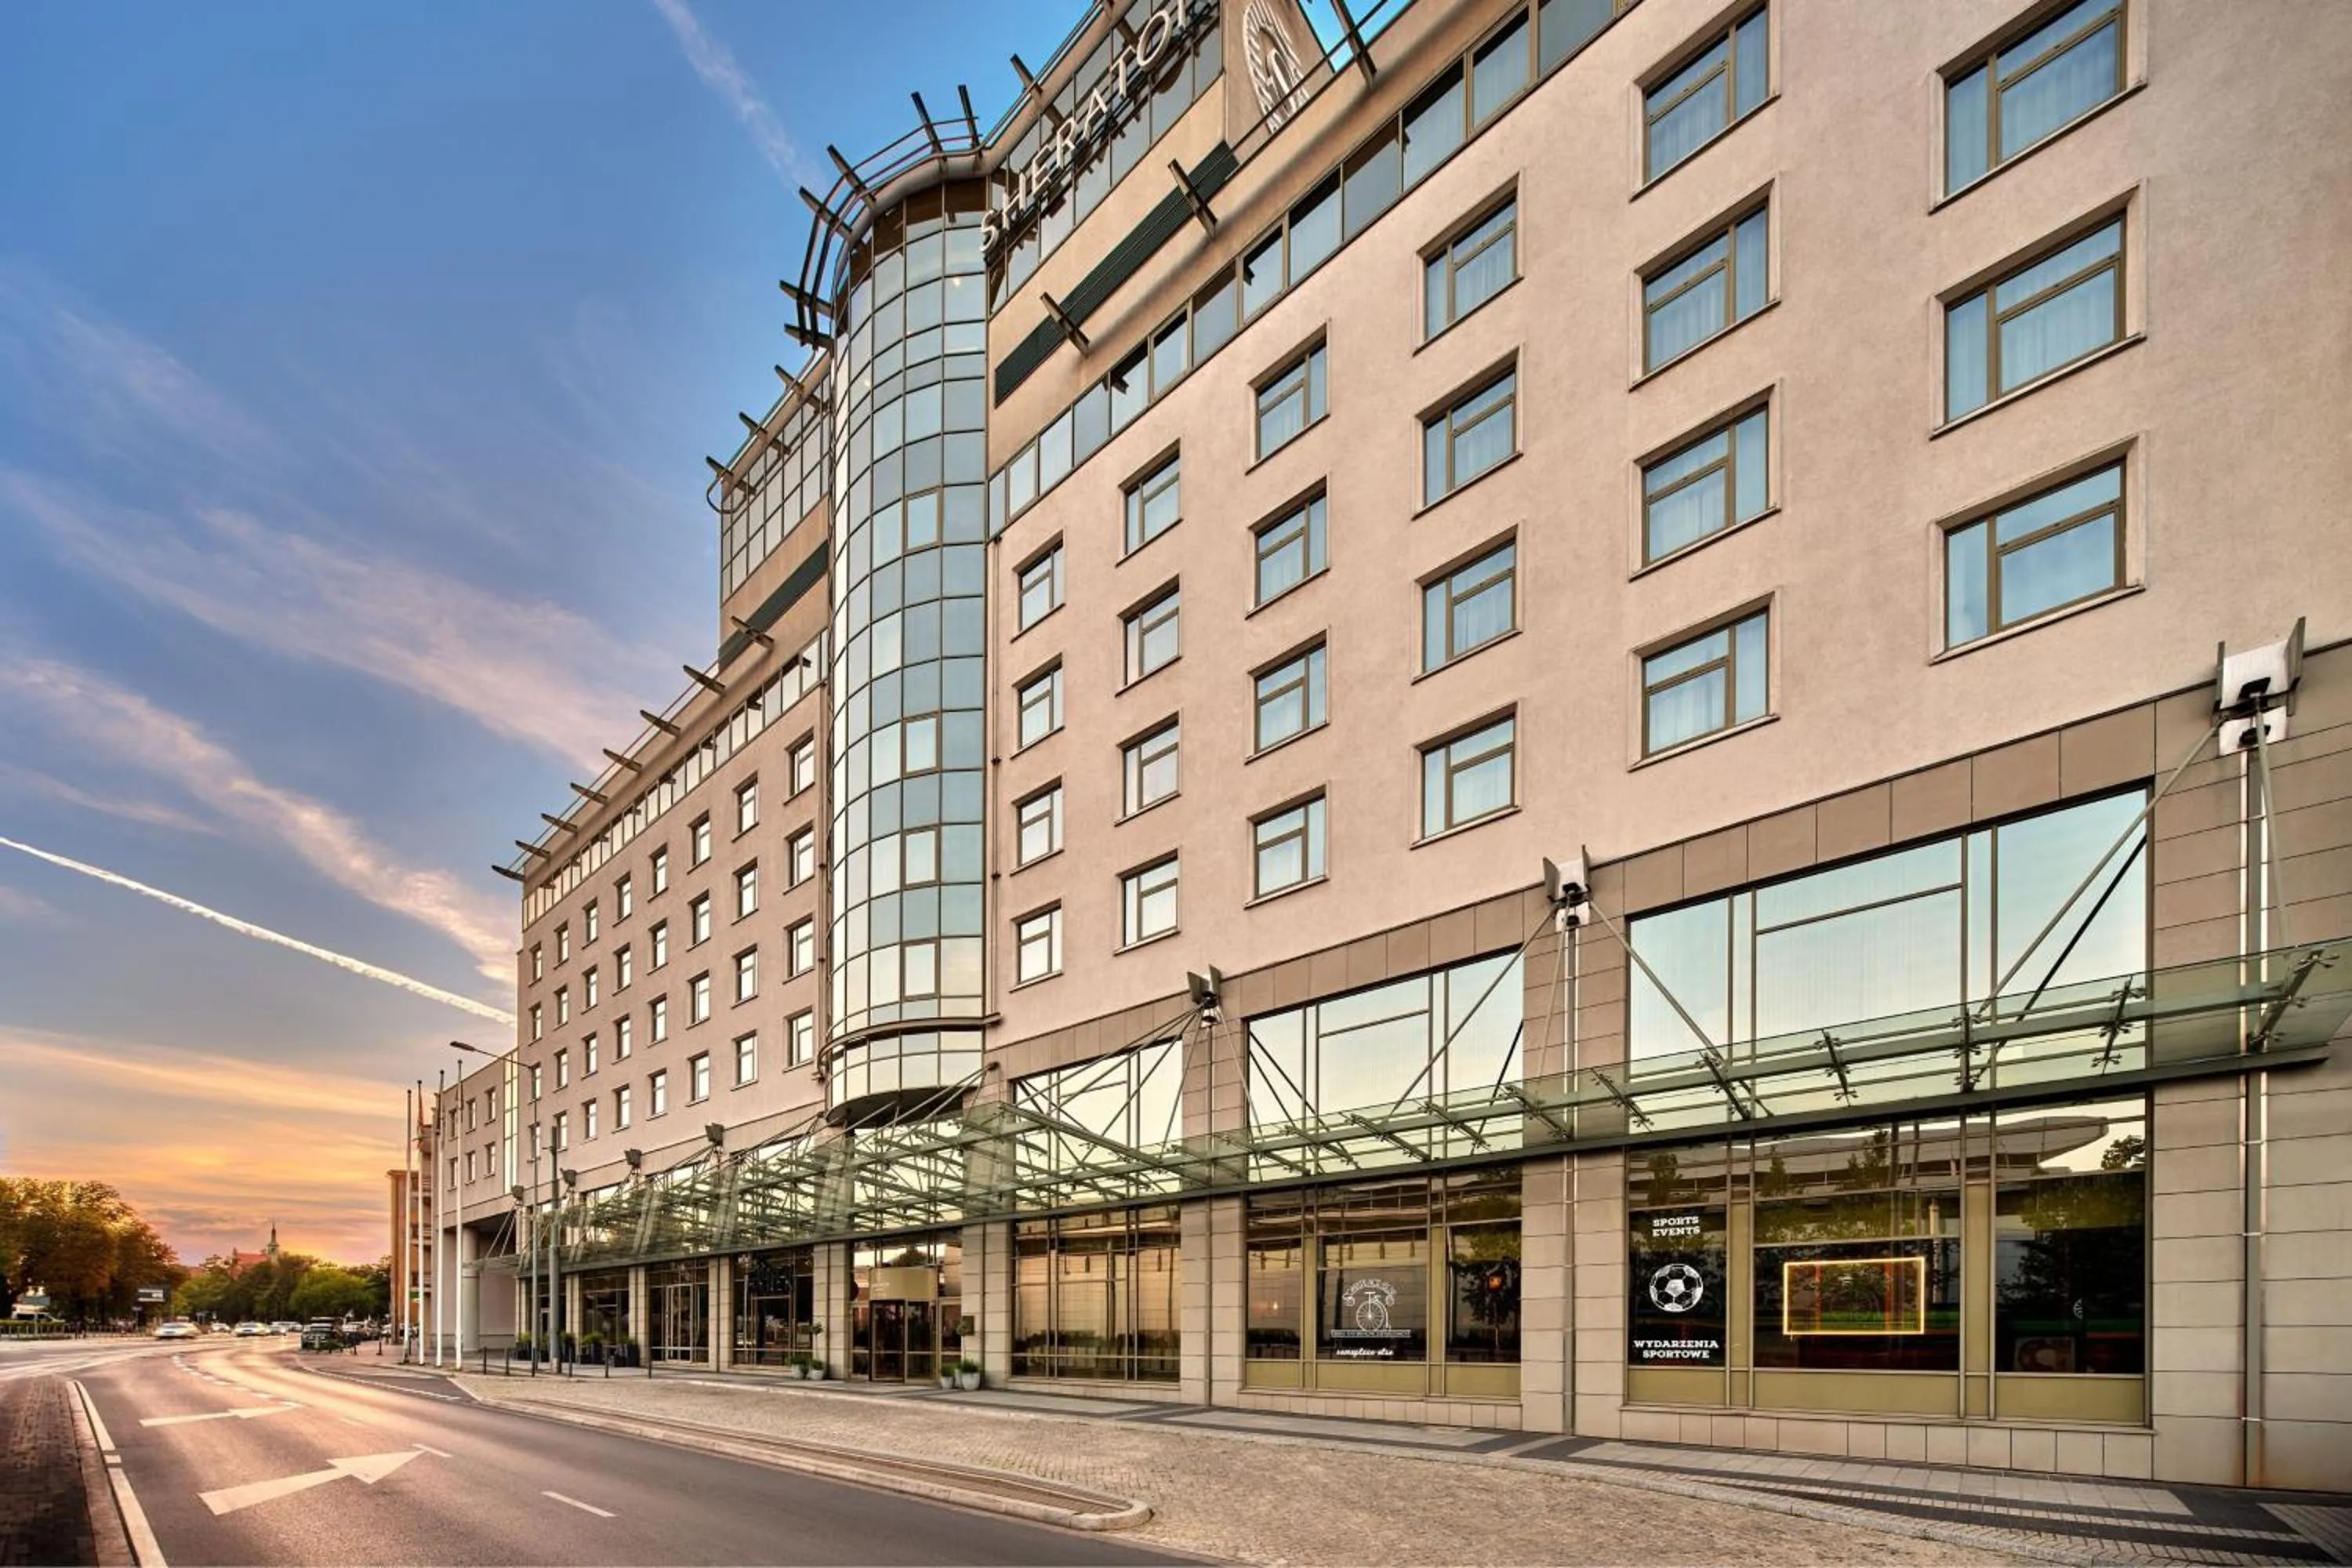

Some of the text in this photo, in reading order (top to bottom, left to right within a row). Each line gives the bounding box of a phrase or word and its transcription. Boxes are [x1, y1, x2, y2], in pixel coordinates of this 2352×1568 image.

[1653, 1216, 1699, 1227] SPORTS
[1652, 1226, 1700, 1237] EVENTS
[1633, 1340, 1719, 1348] WYDARZENIA
[1642, 1349, 1710, 1359] SPORTOWE
